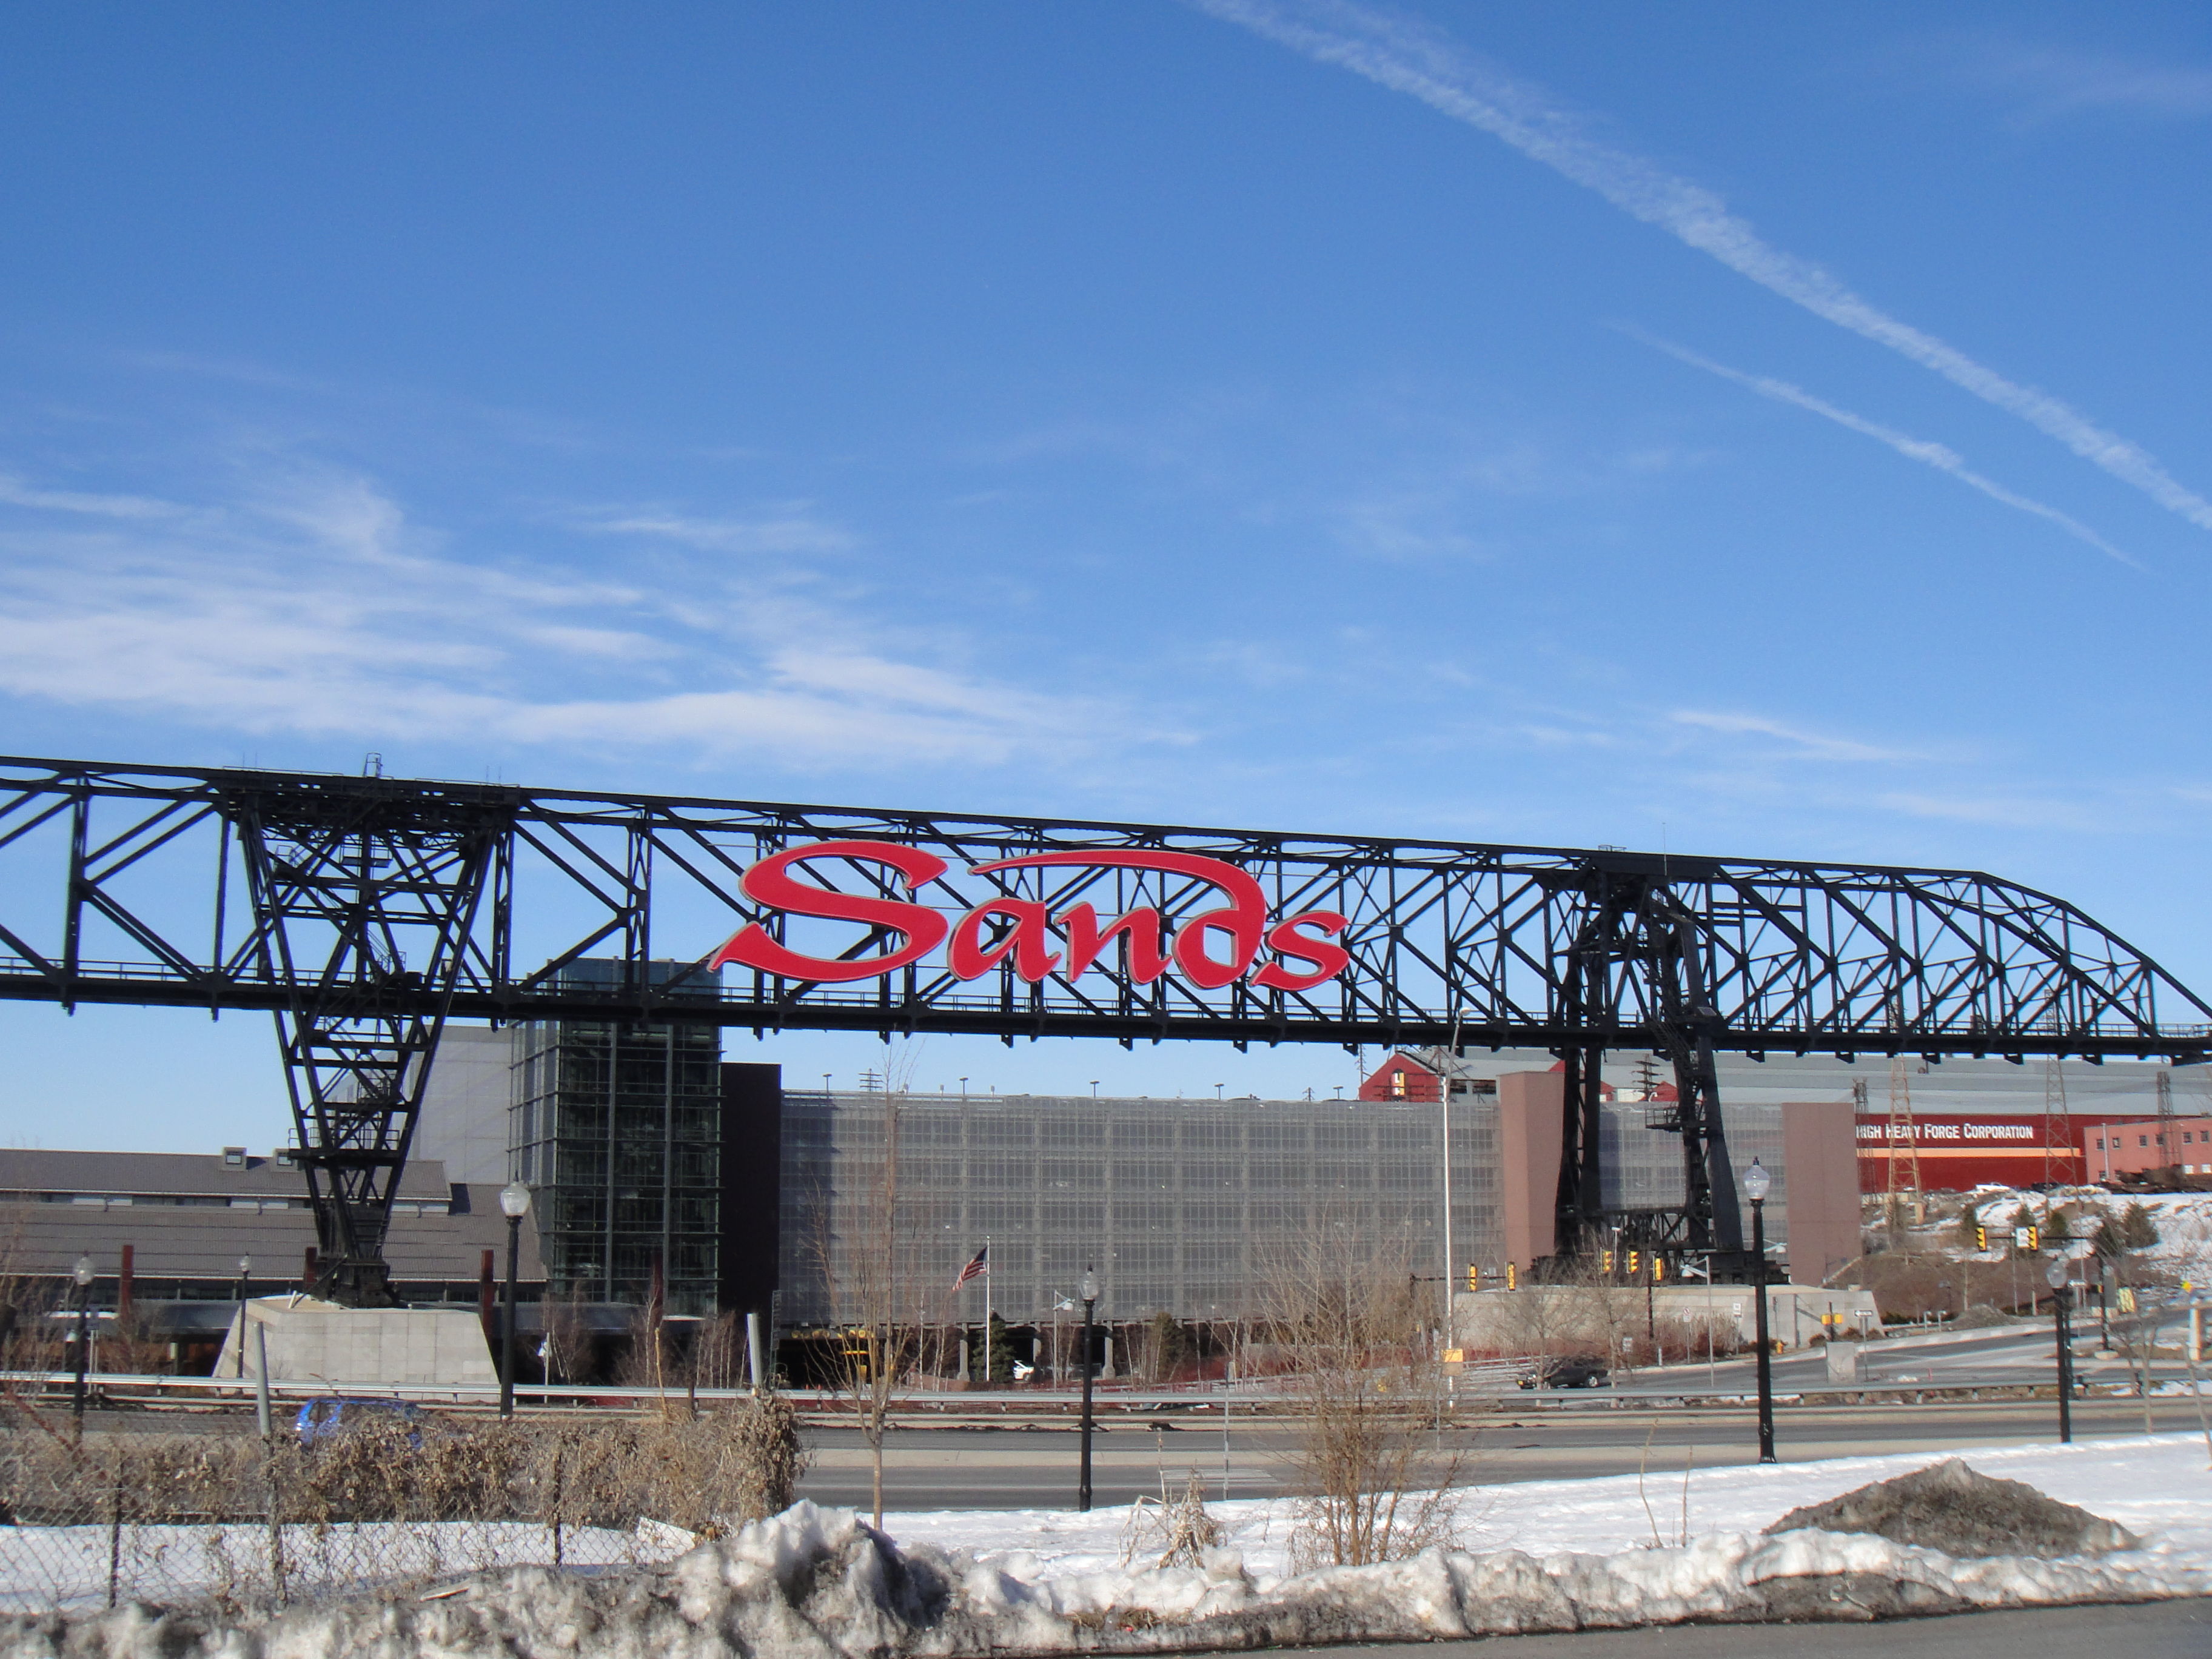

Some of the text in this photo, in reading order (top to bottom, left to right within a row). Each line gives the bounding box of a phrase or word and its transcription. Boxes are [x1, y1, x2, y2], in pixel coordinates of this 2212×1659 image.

[708, 840, 1349, 990] Sands
[1925, 1123, 1960, 1139] FORGE
[1964, 1123, 2034, 1139] CORPORATION
